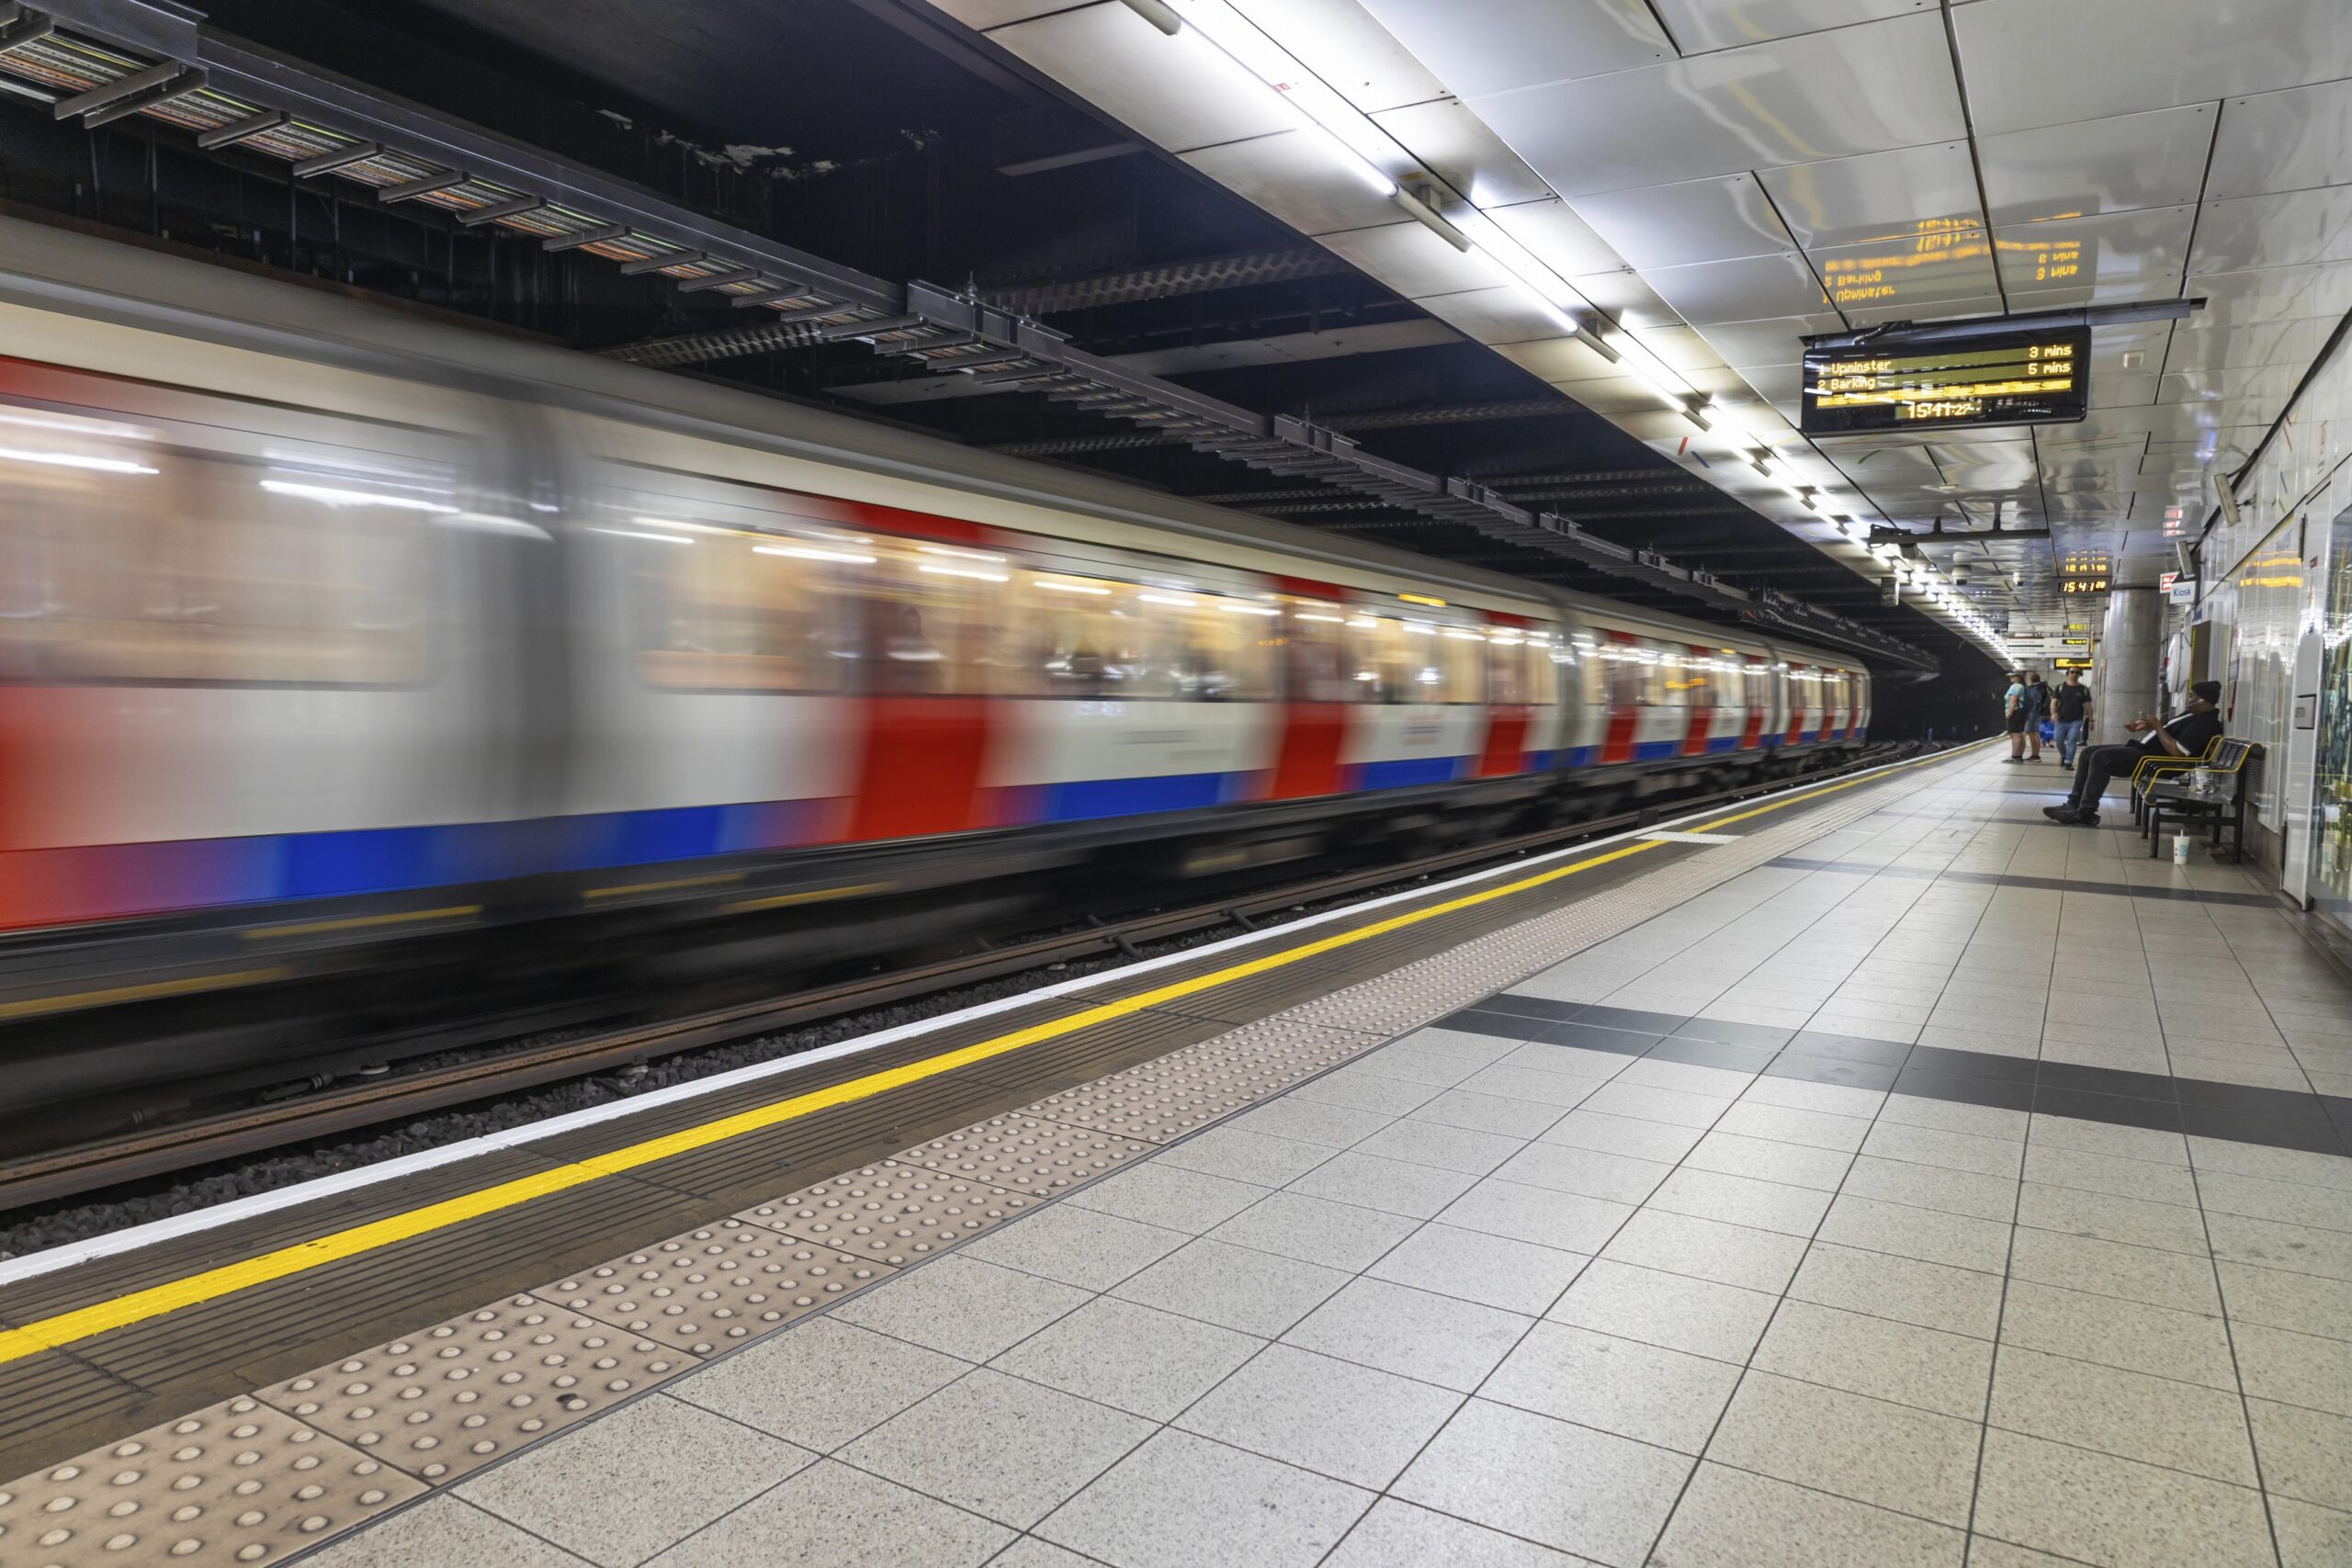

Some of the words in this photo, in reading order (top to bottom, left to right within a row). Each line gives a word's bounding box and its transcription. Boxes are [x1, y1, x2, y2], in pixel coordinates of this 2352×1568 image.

[1818, 364, 1826, 375] 1
[1831, 360, 1892, 376] Upminster
[2029, 345, 2039, 358] 3
[2044, 344, 2073, 357] mins
[1817, 379, 1826, 390] 2
[1830, 378, 1876, 390] Barking
[2028, 363, 2038, 375] 5
[2043, 362, 2072, 374] mins
[2173, 587, 2191, 598] Kiosk
